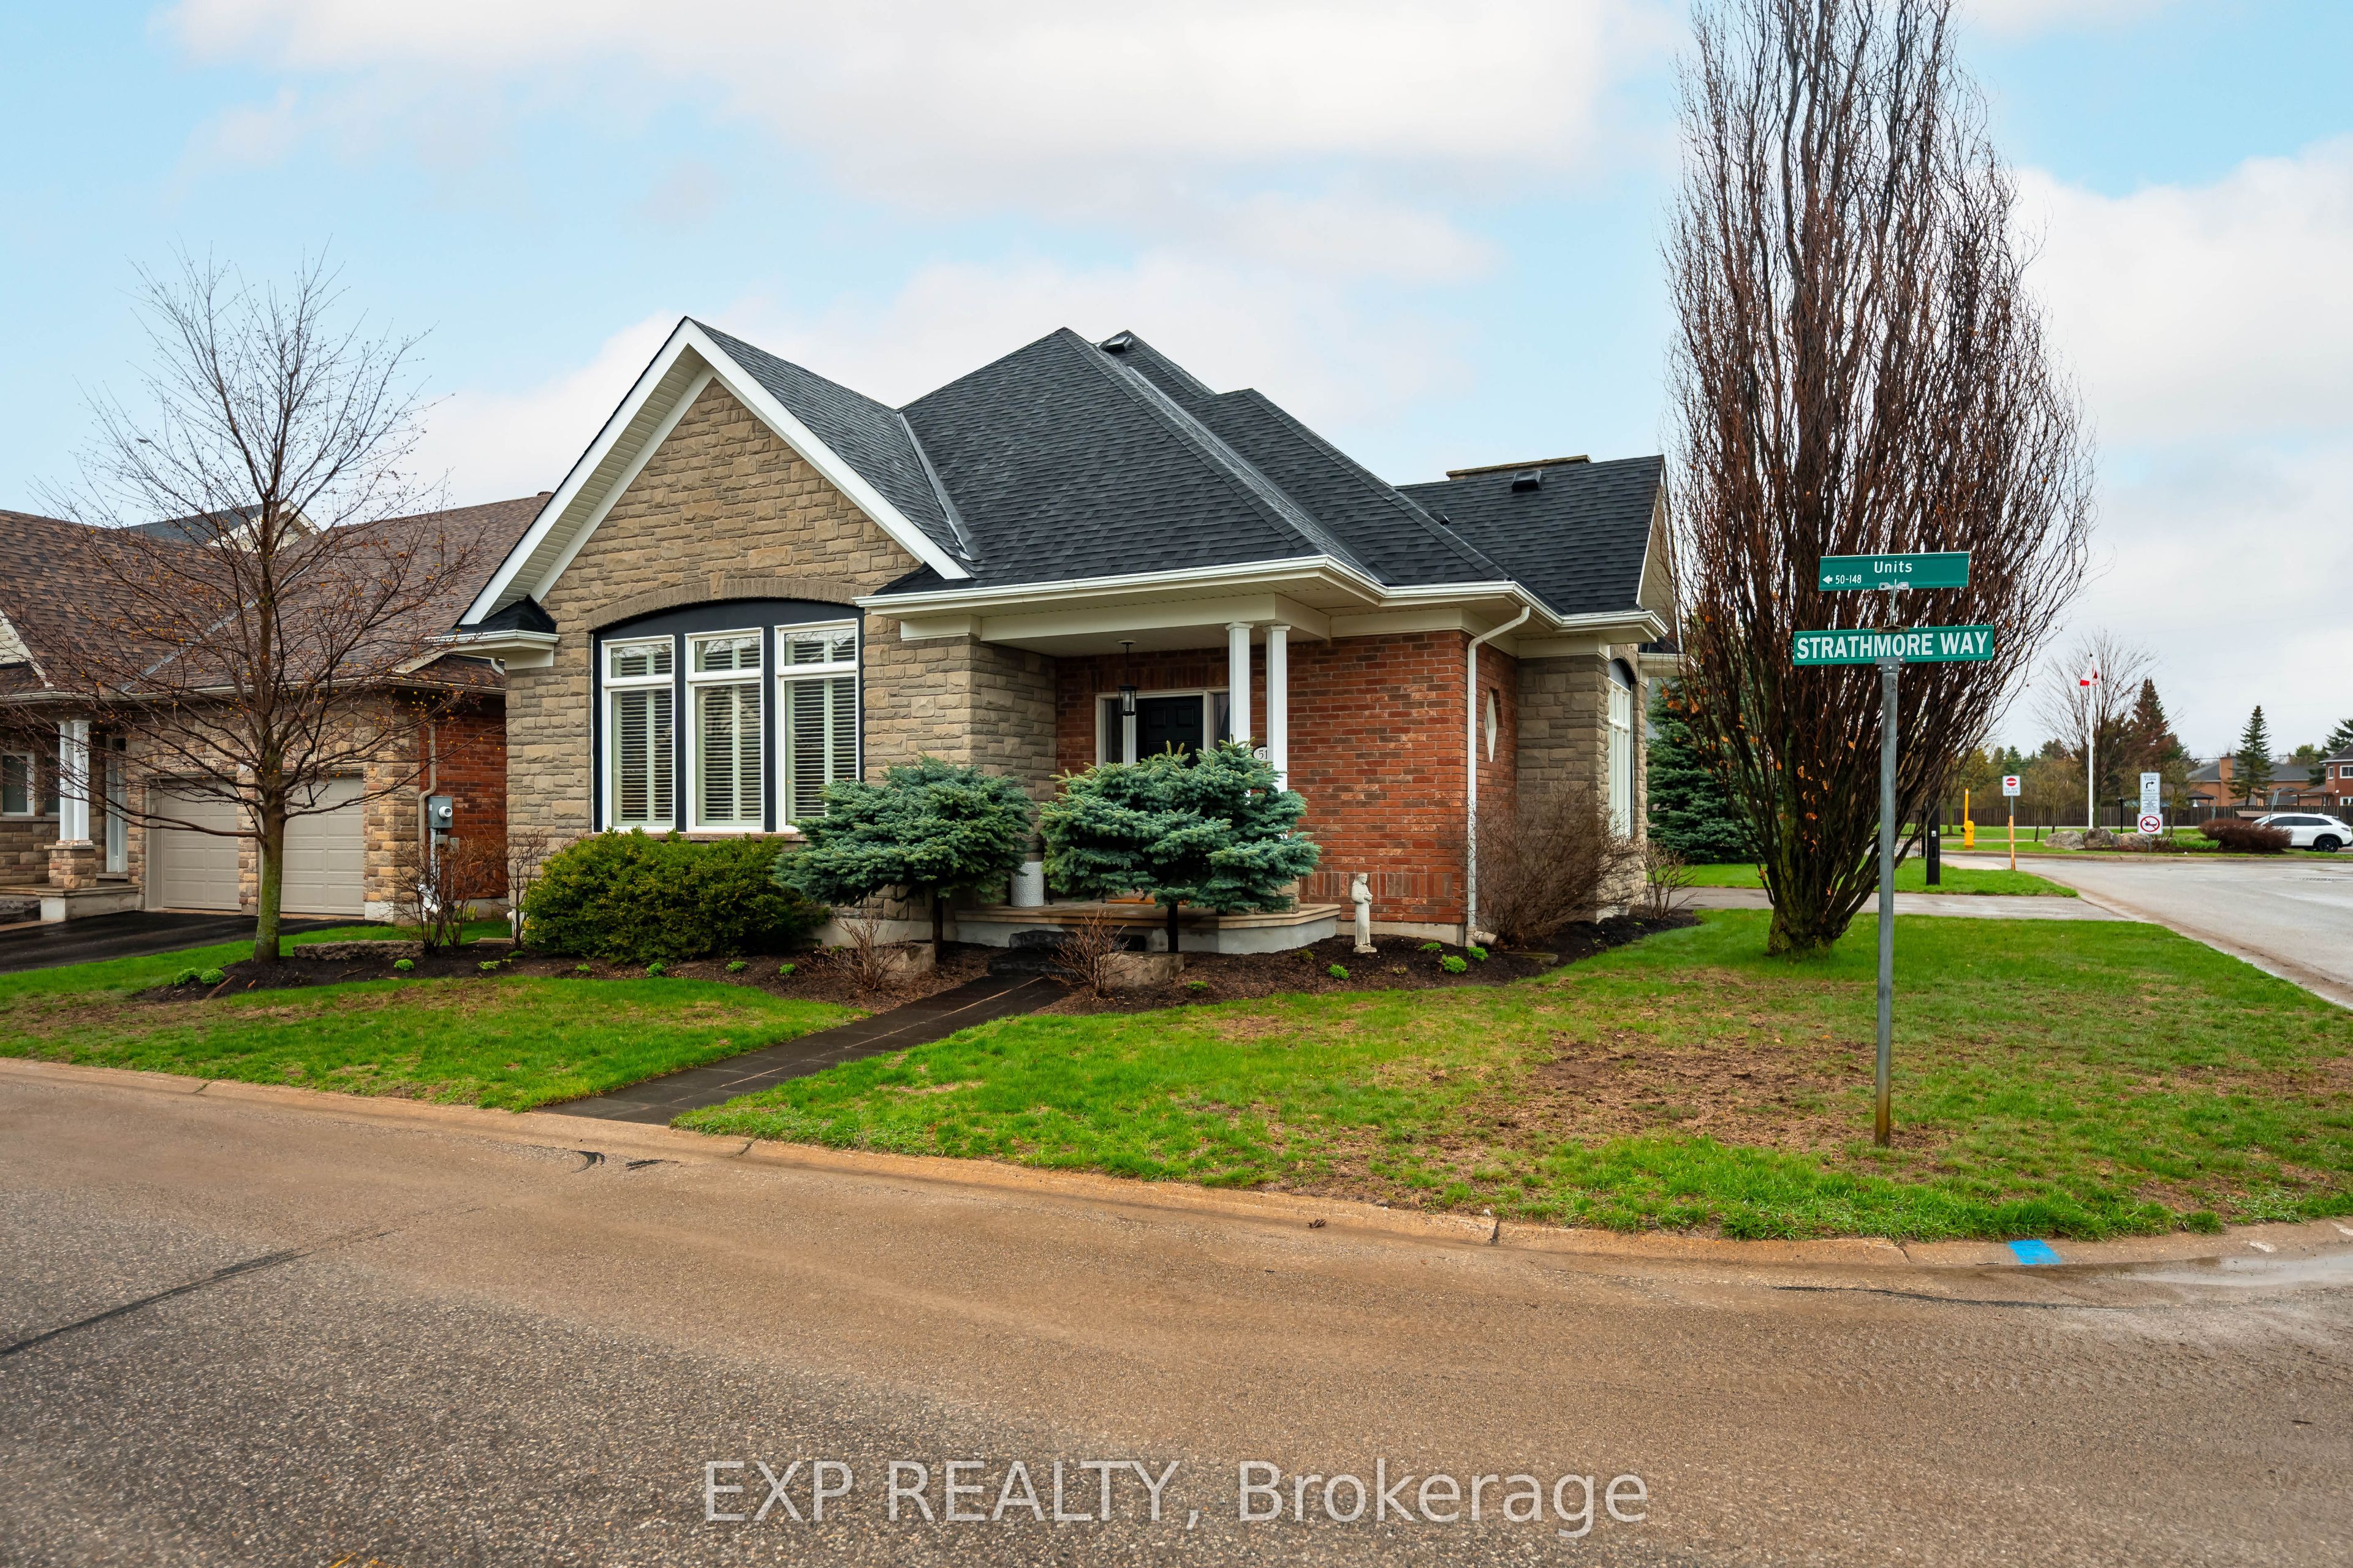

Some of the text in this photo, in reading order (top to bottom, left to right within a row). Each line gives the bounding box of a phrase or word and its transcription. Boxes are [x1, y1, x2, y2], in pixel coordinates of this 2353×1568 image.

[1874, 561, 1912, 574] Units
[1835, 574, 1862, 585] 50-148
[1797, 632, 1988, 659] STRATHMORE WAY
